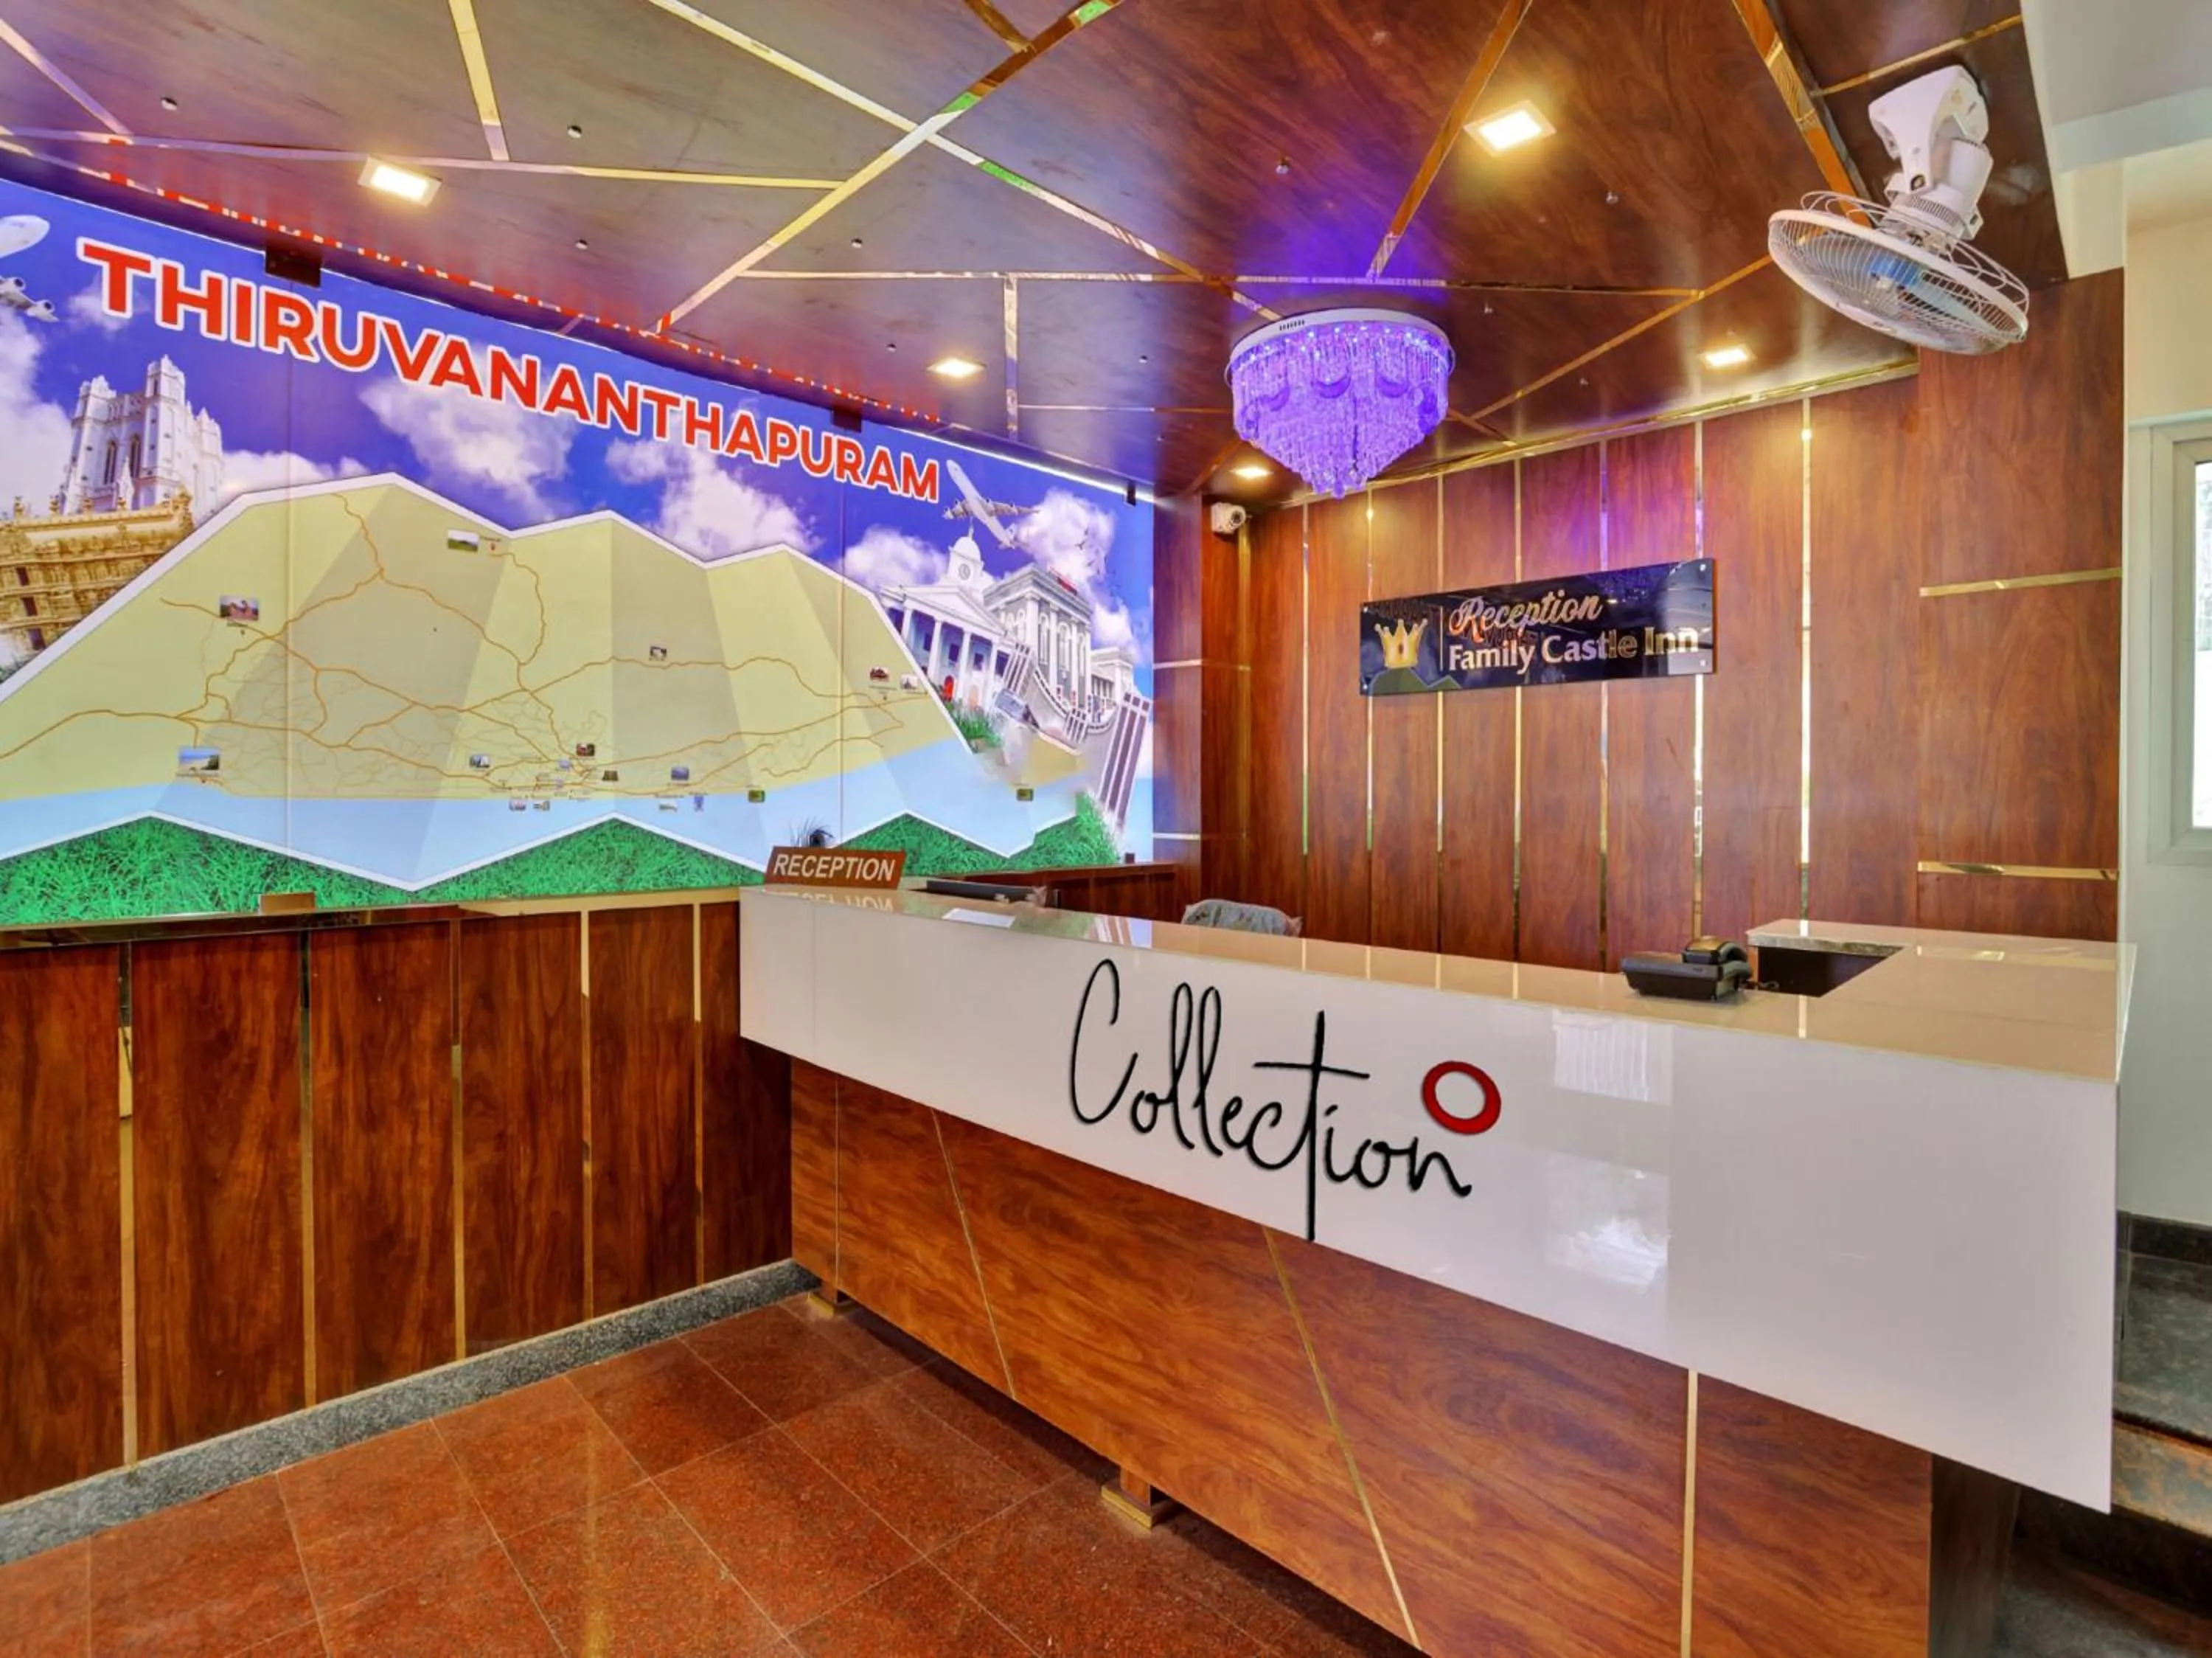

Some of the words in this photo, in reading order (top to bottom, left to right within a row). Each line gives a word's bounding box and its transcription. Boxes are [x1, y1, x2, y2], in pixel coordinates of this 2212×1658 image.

[77, 238, 941, 504] THIRUVANANTHAPURAM
[1448, 589, 1604, 643] Reception
[1448, 639, 1535, 675] Family
[1541, 628, 1638, 664] Castle
[1644, 626, 1698, 656] Inn
[773, 853, 896, 882] RECEPTION
[1070, 958, 1472, 1241] Collection
